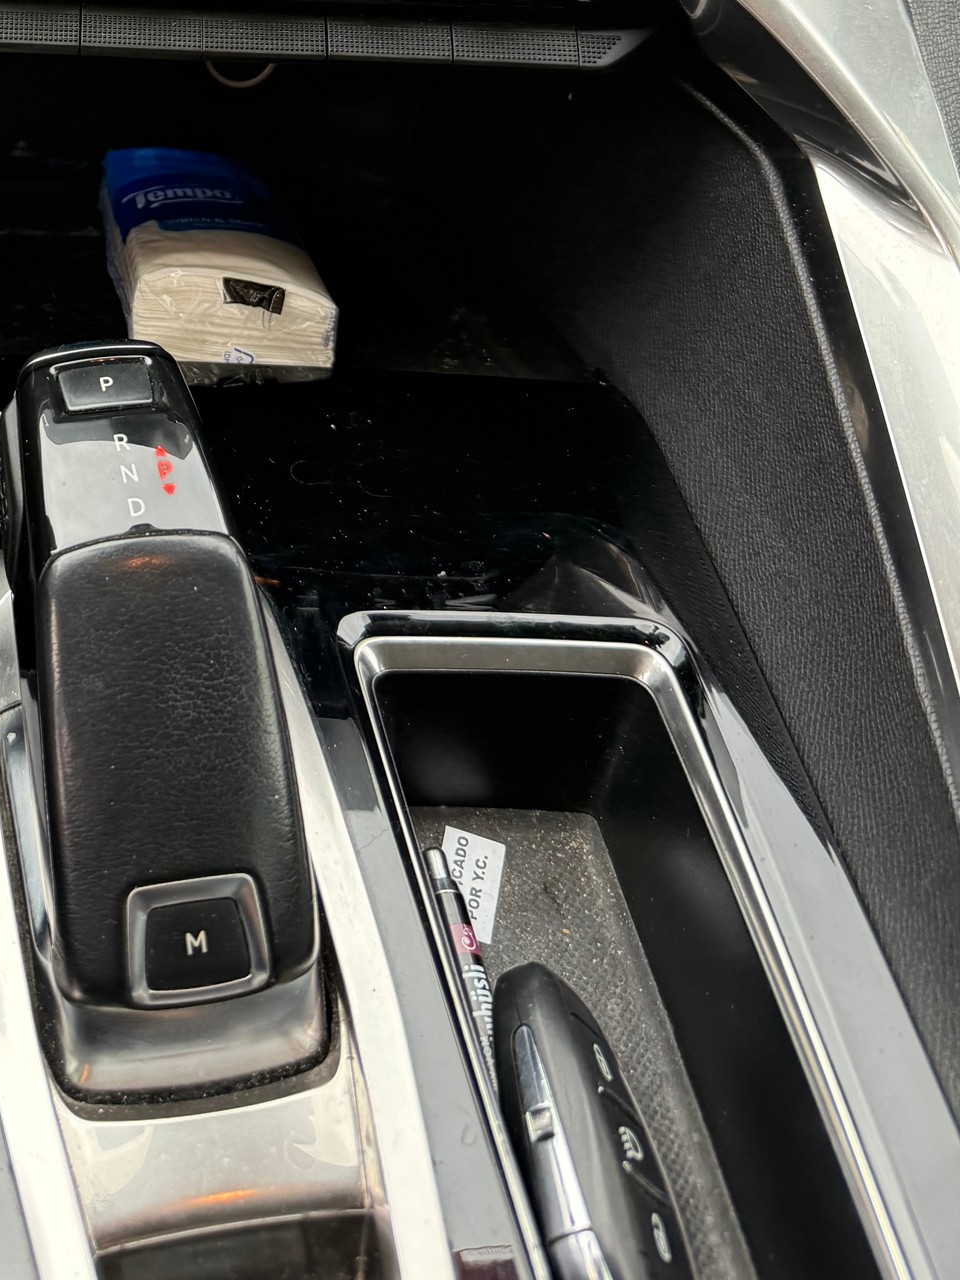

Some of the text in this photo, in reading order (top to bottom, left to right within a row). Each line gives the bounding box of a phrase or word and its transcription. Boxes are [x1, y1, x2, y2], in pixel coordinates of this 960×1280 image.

[122, 185, 233, 209] Tempo
[99, 376, 114, 392] P
[113, 433, 130, 451] R
[120, 463, 138, 483] N
[157, 460, 173, 481] P
[127, 497, 145, 517] D
[452, 836, 469, 885] CADO
[472, 855, 488, 882] Y.C.
[185, 930, 208, 955] M
